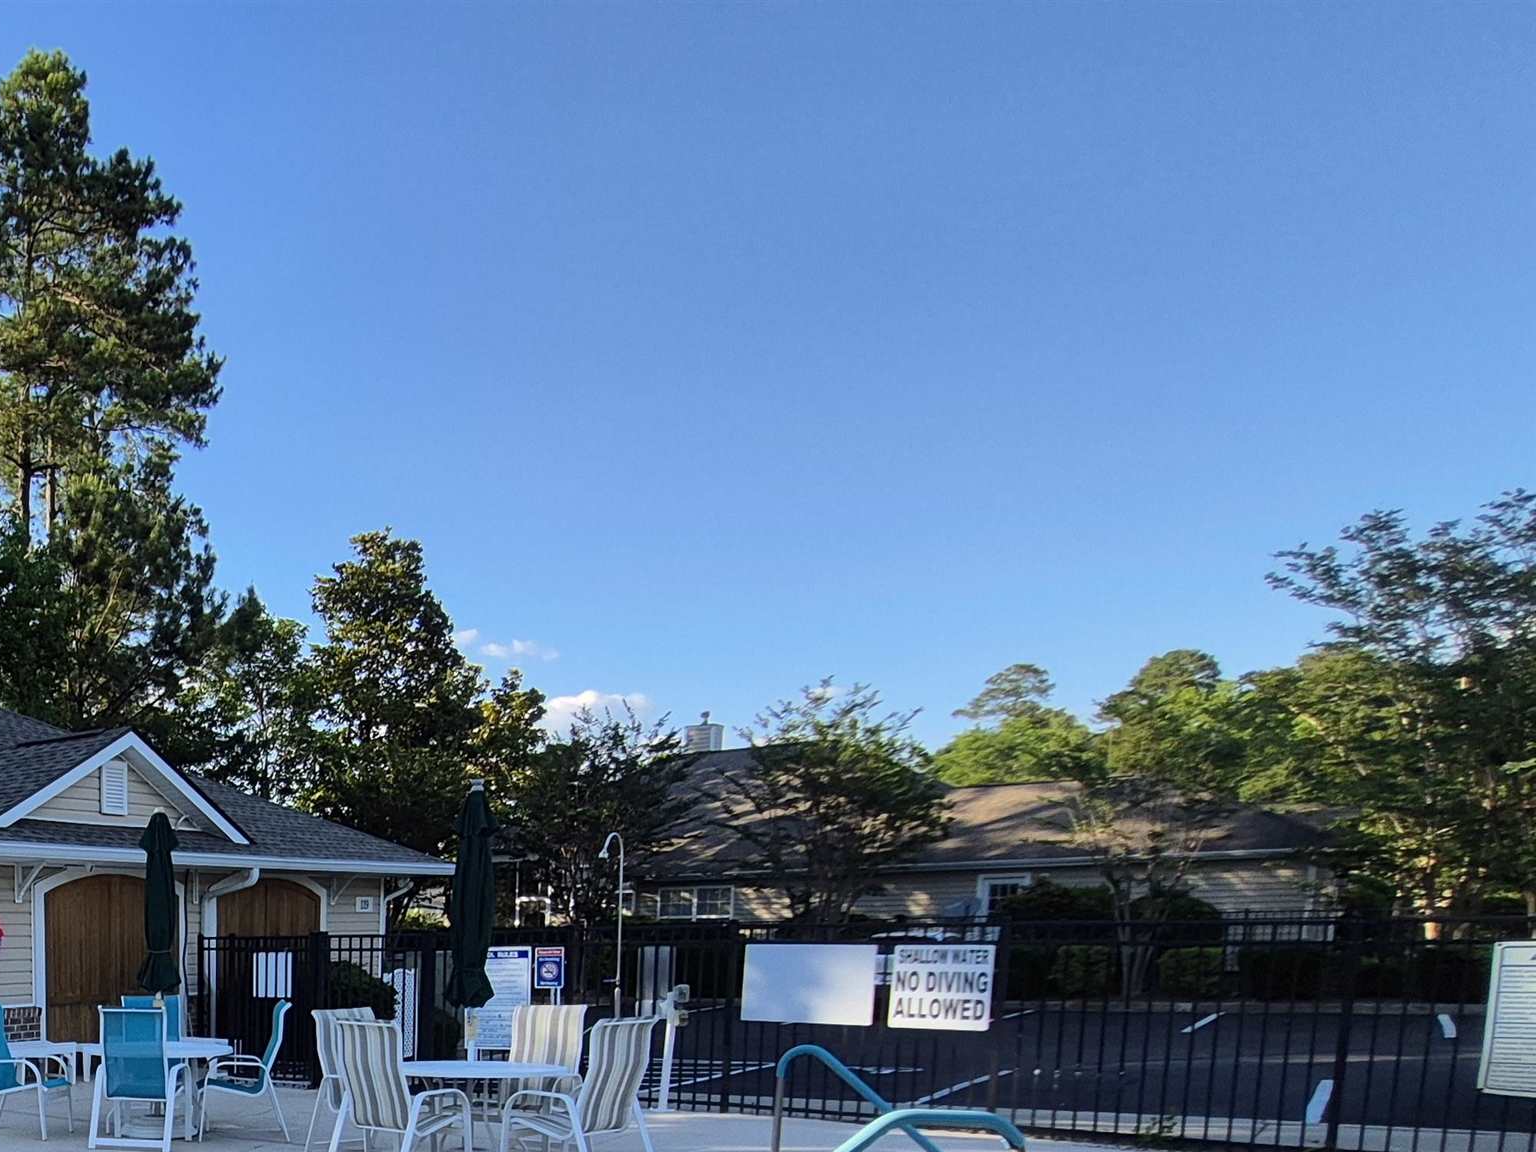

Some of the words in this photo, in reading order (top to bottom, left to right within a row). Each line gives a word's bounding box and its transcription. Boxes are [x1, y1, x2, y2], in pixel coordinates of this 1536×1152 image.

[899, 949, 948, 964] SHALLOW
[952, 949, 990, 964] WATER
[895, 970, 920, 992] NO
[926, 971, 989, 994] DIVING
[893, 997, 986, 1021] ALLOWED
